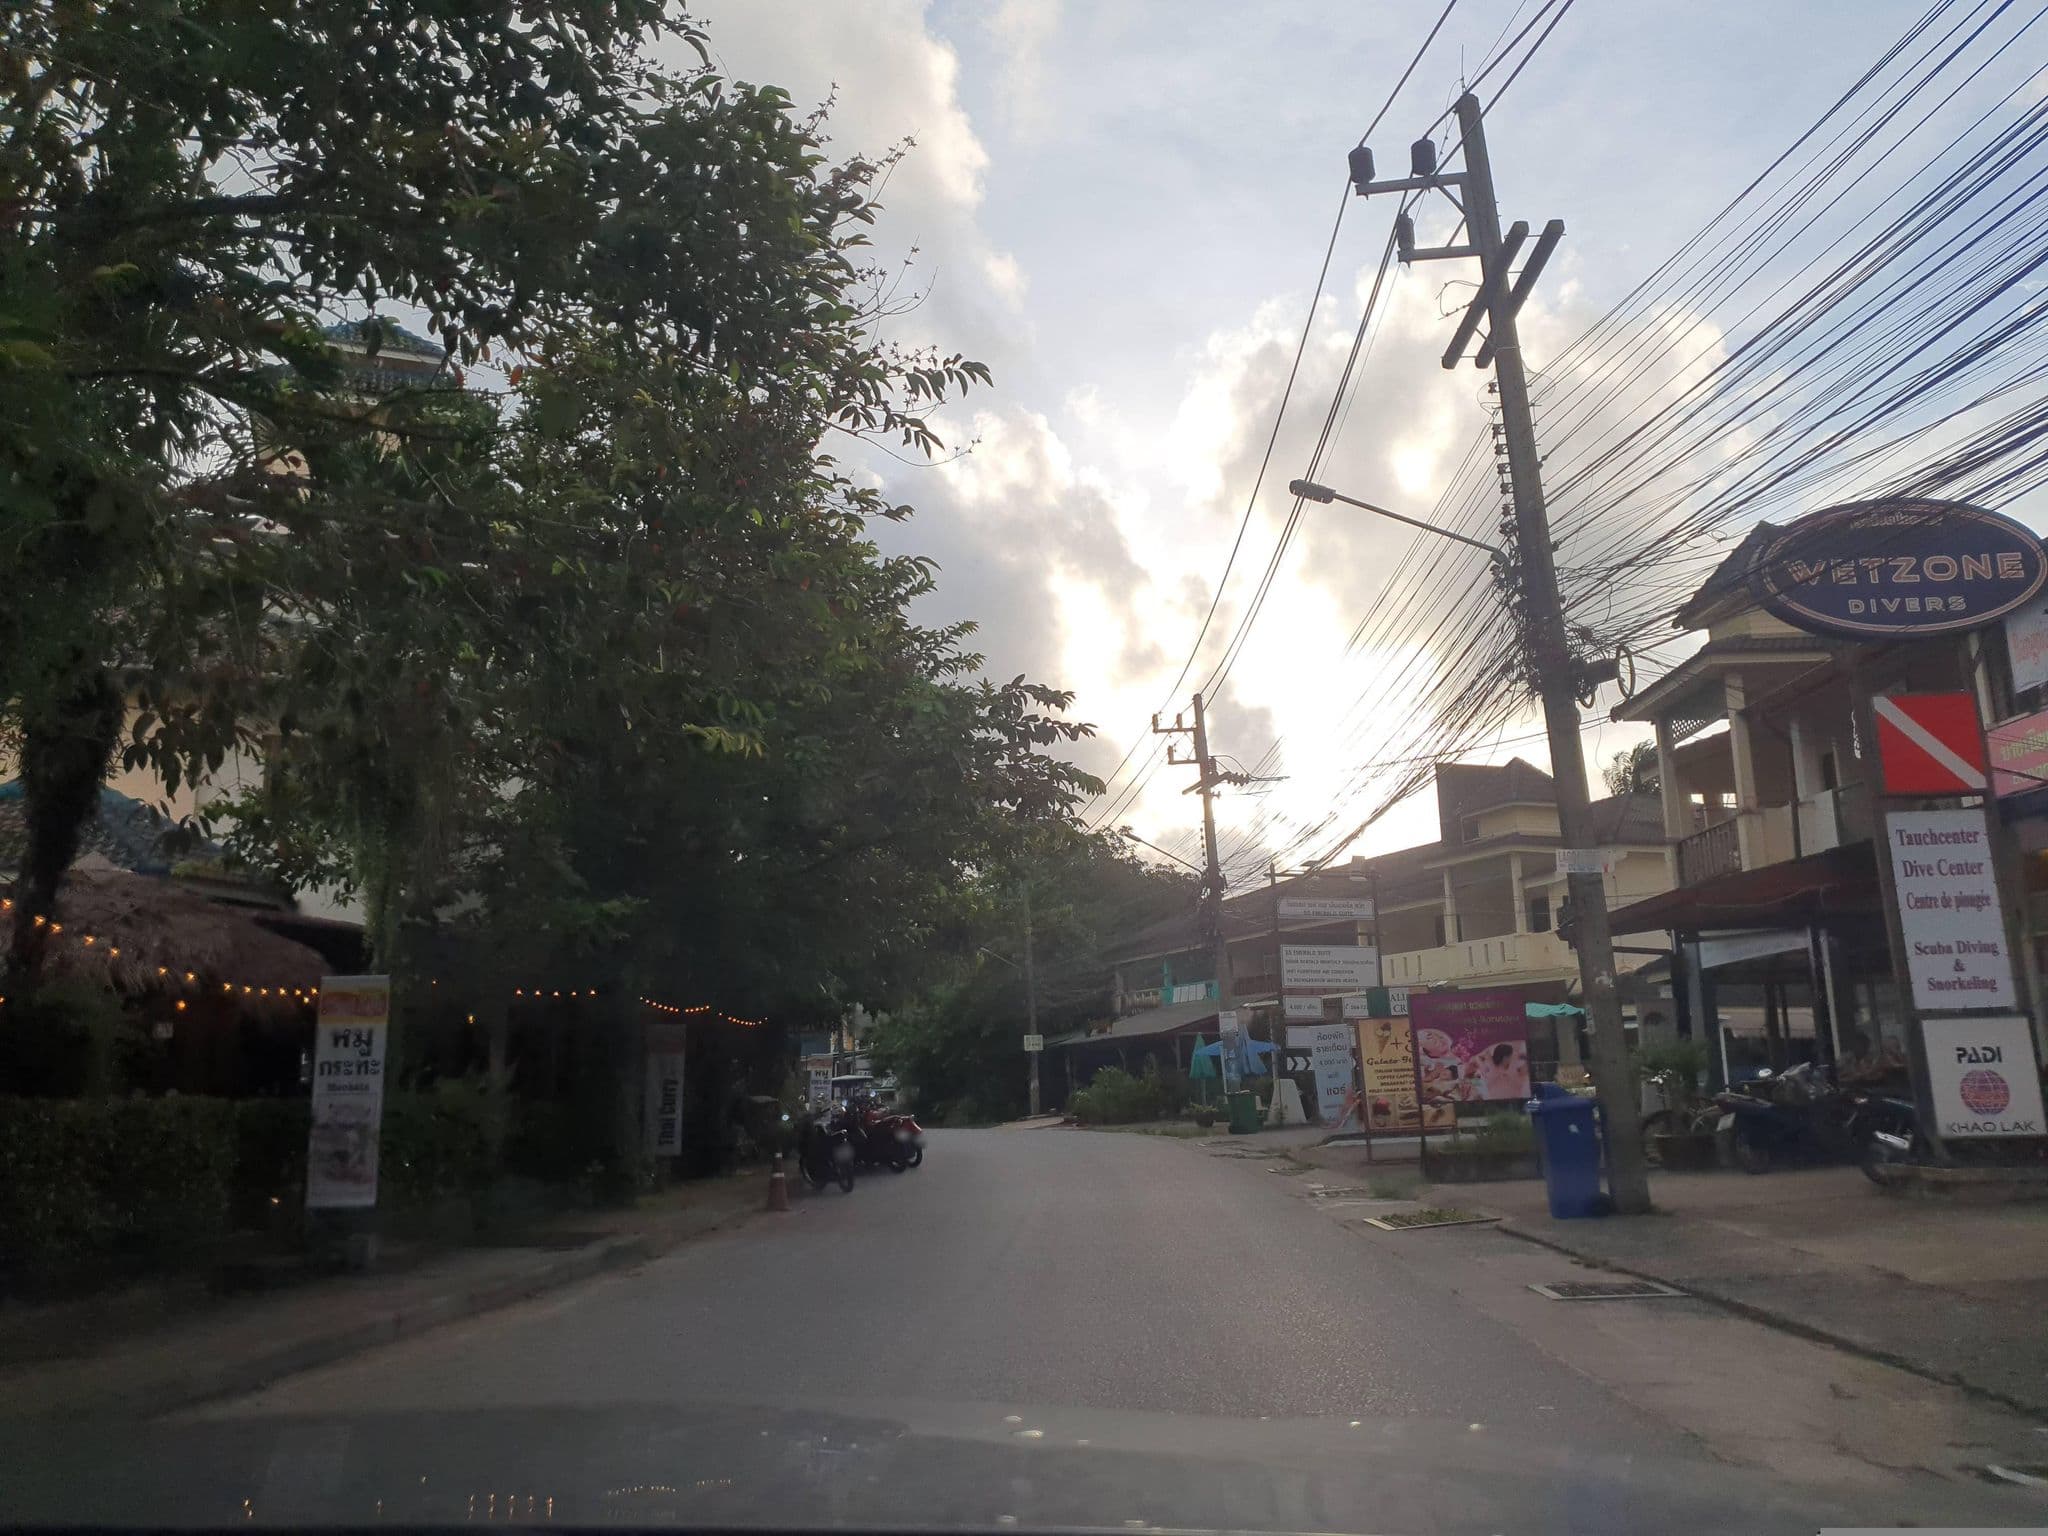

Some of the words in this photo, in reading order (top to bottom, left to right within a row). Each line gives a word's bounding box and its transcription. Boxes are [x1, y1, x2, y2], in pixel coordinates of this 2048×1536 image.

[1785, 552, 2026, 586] WETZONE
[1848, 596, 1967, 614] DIVERS
[1895, 829, 1981, 847] Tauchcenter
[1902, 860, 1934, 878] Dive
[1937, 858, 1984, 876] Center
[1906, 891, 1939, 910] Centre
[1941, 891, 1953, 909] de
[1914, 941, 1954, 956] Scuba
[1956, 940, 1999, 957] Diving
[1953, 960, 1965, 972] &
[1927, 976, 1998, 993] Snorkeling
[331, 1028, 375, 1058] หมู
[1956, 1046, 2003, 1064] PADI
[319, 1059, 381, 1077] กระทะ
[1947, 1121, 1997, 1134] KHAO
[2001, 1120, 2036, 1132] LAK
